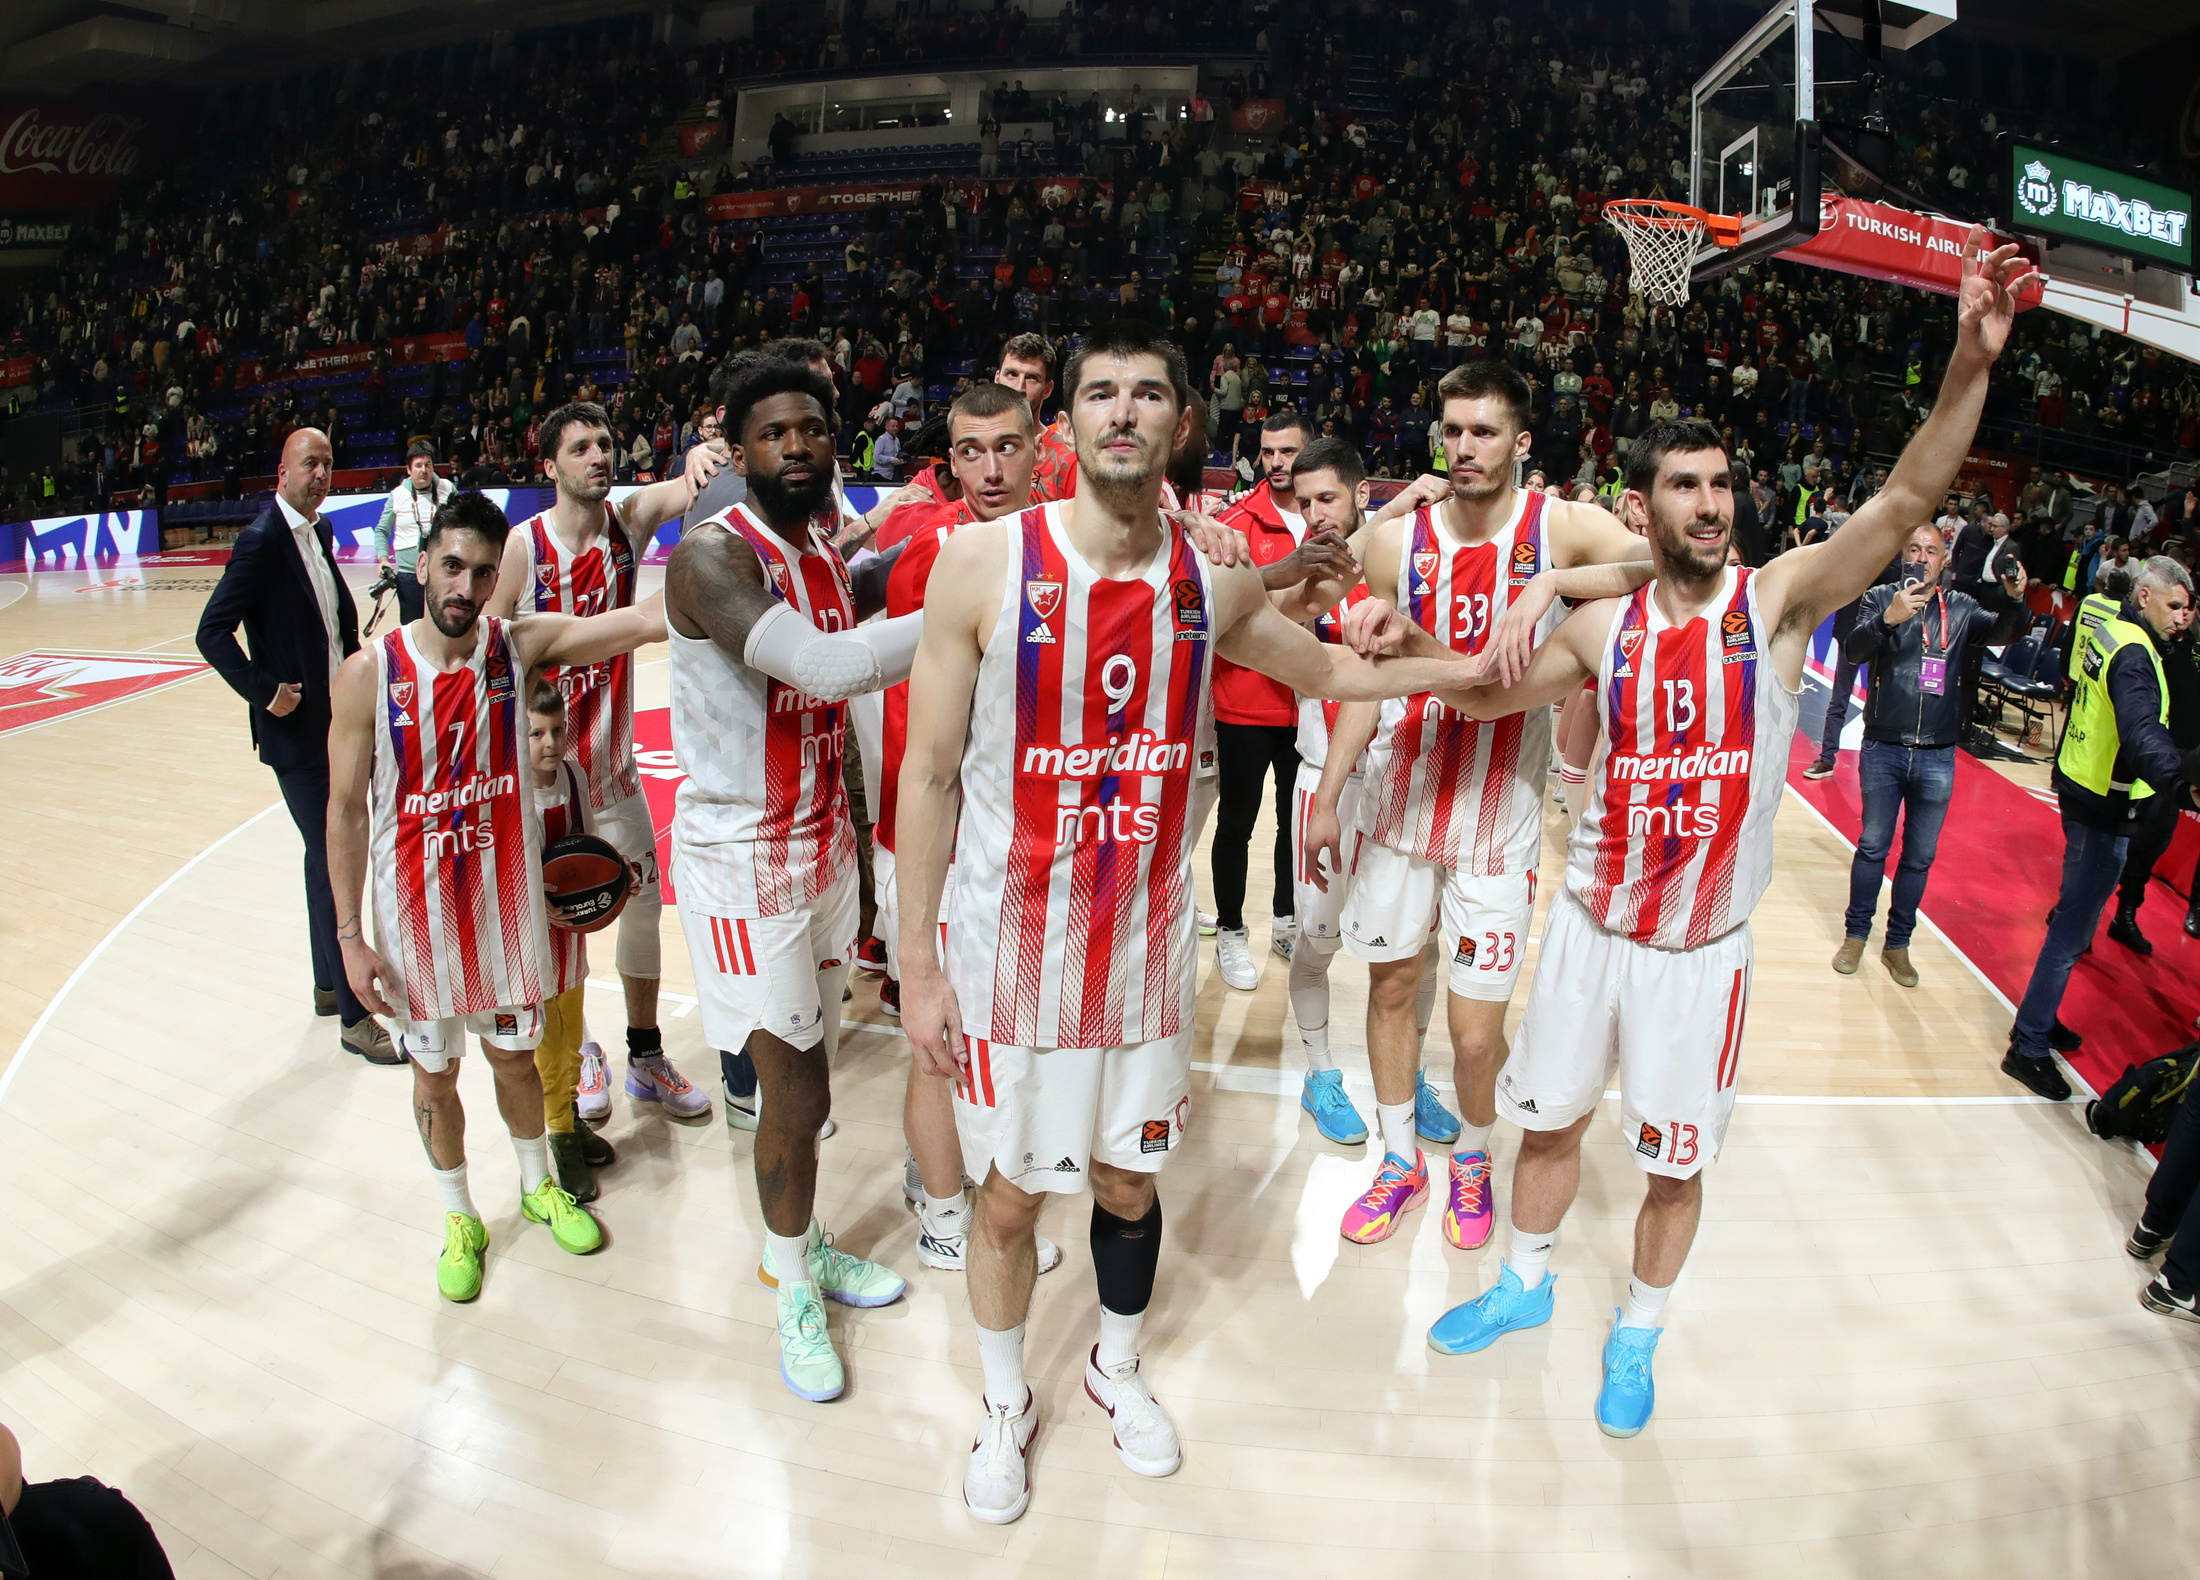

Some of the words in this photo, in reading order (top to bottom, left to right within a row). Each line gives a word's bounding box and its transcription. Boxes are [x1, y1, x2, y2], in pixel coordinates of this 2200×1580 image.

[1845, 212, 1922, 246] TURKISH
[1455, 593, 1489, 639] 33
[1026, 635, 1057, 645] adidas
[1722, 652, 1757, 664] oneteam
[557, 664, 612, 695] mts
[1102, 654, 1136, 715] 9
[393, 719, 414, 727] adidas
[1663, 678, 1697, 732] 13
[448, 721, 465, 766] 7
[1023, 733, 1187, 777] meridian
[1613, 746, 1749, 781] meridian
[404, 772, 514, 815] meridian
[1056, 795, 1160, 843] mts
[1628, 798, 1719, 837] mts
[423, 821, 495, 859] mts
[1480, 932, 1515, 972] 33
[523, 1003, 538, 1037] 7
[1518, 1103, 1539, 1114] adidas
[1667, 1122, 1699, 1166] 13
